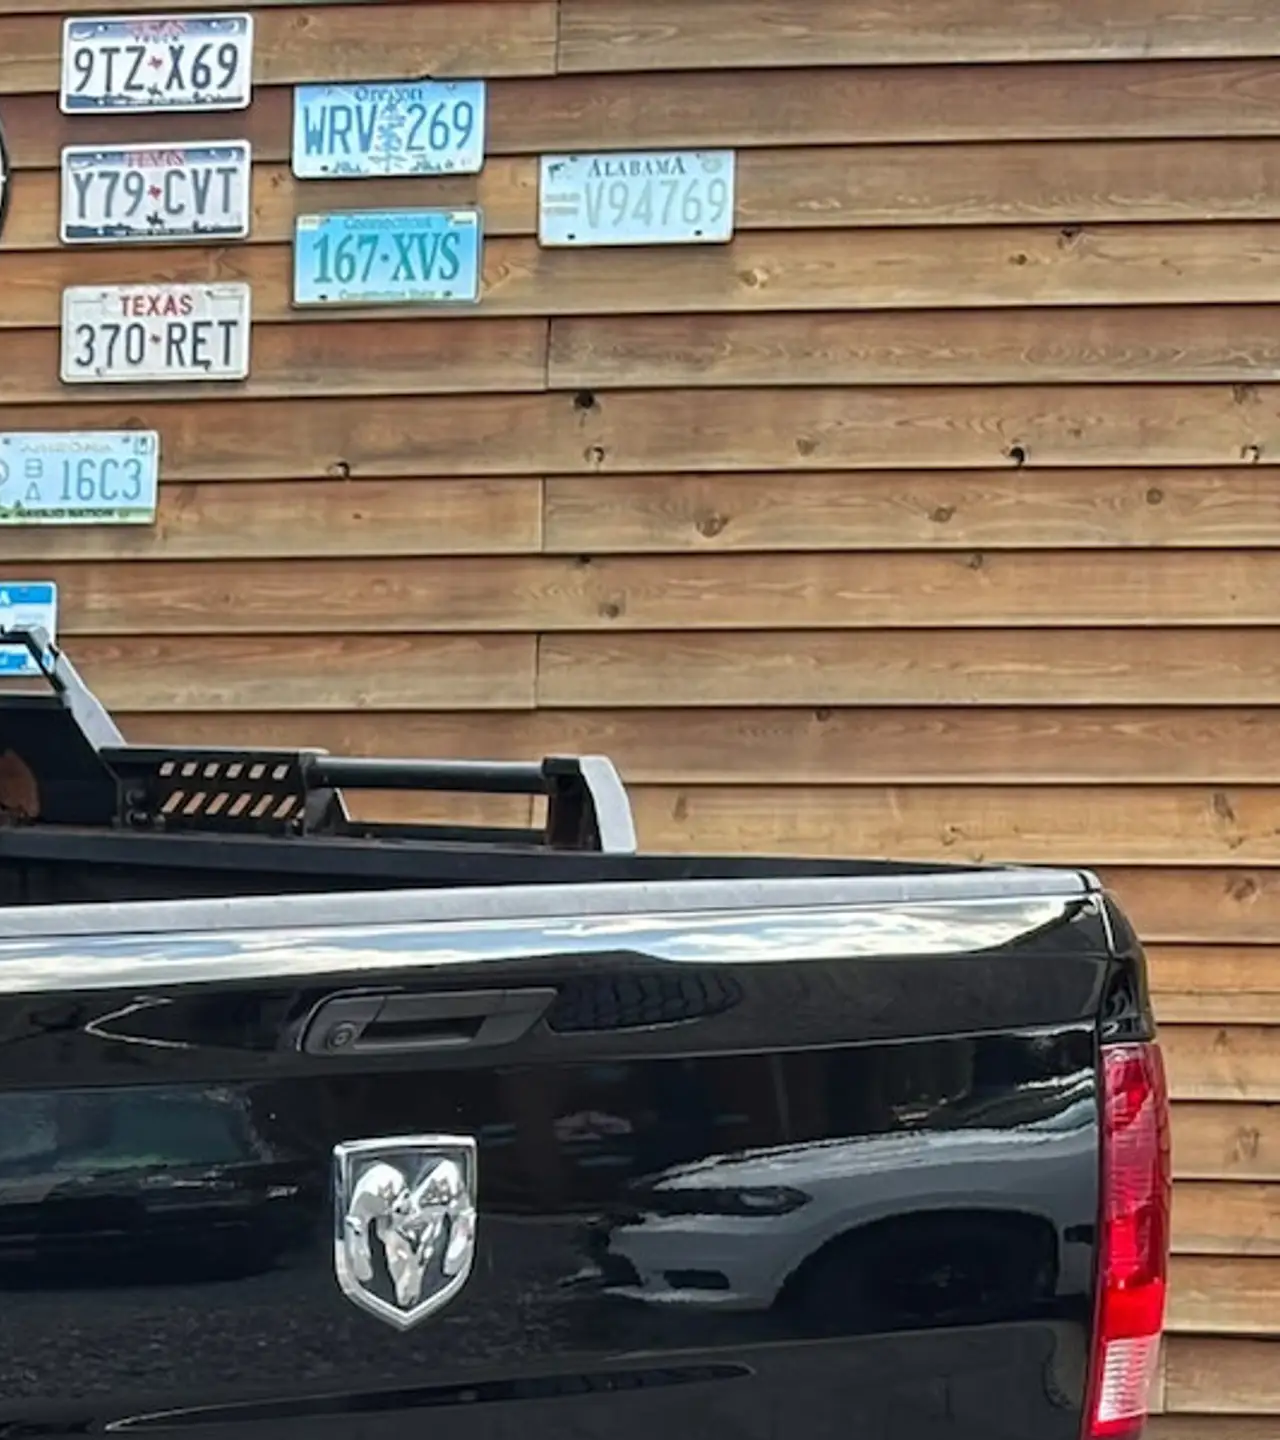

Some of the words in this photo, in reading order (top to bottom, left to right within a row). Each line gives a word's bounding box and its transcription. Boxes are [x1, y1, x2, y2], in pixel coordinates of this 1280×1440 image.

[74, 46, 146, 92] 9TZ
[165, 43, 238, 90] X69
[304, 104, 378, 155] WRV
[405, 101, 473, 151] 269
[589, 156, 686, 177] ALABAMA
[73, 171, 145, 219] Y79
[164, 168, 237, 215] CVT
[584, 177, 727, 229] V94769
[120, 293, 194, 317] TEXAS
[75, 322, 146, 369] 370
[166, 320, 239, 367] RET
[59, 458, 142, 501] 16C3
